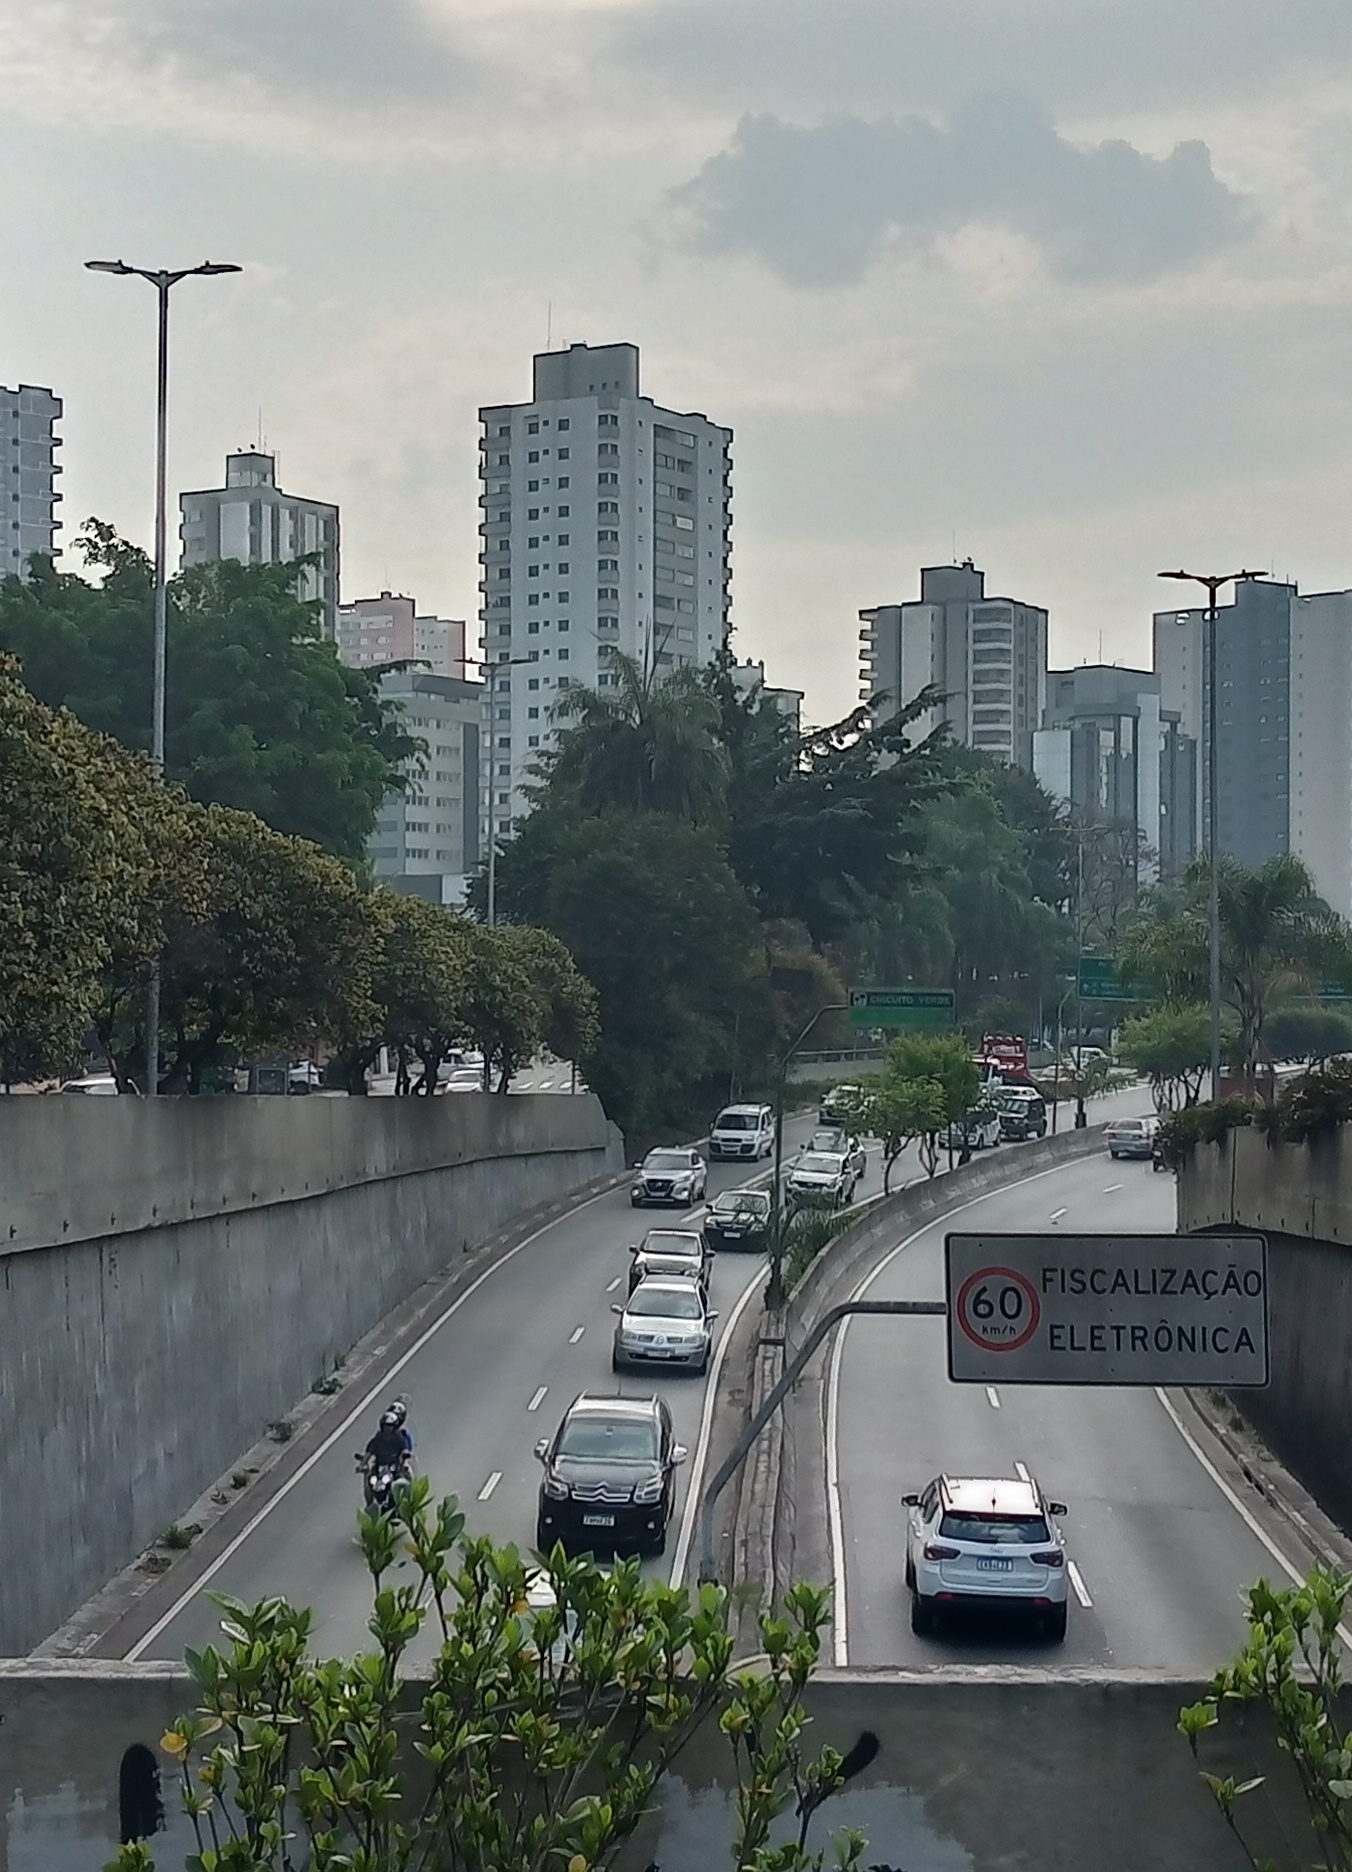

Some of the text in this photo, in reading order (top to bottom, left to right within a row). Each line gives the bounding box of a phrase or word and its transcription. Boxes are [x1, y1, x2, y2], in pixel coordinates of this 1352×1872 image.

[870, 996, 951, 1005] CIRCUITO VERDE
[1041, 1264, 1263, 1300] FISCALIZAÇÃO
[972, 1286, 1023, 1320] 60
[981, 1324, 1017, 1336] km/h
[1048, 1319, 1256, 1355] ELETRÔNICA
